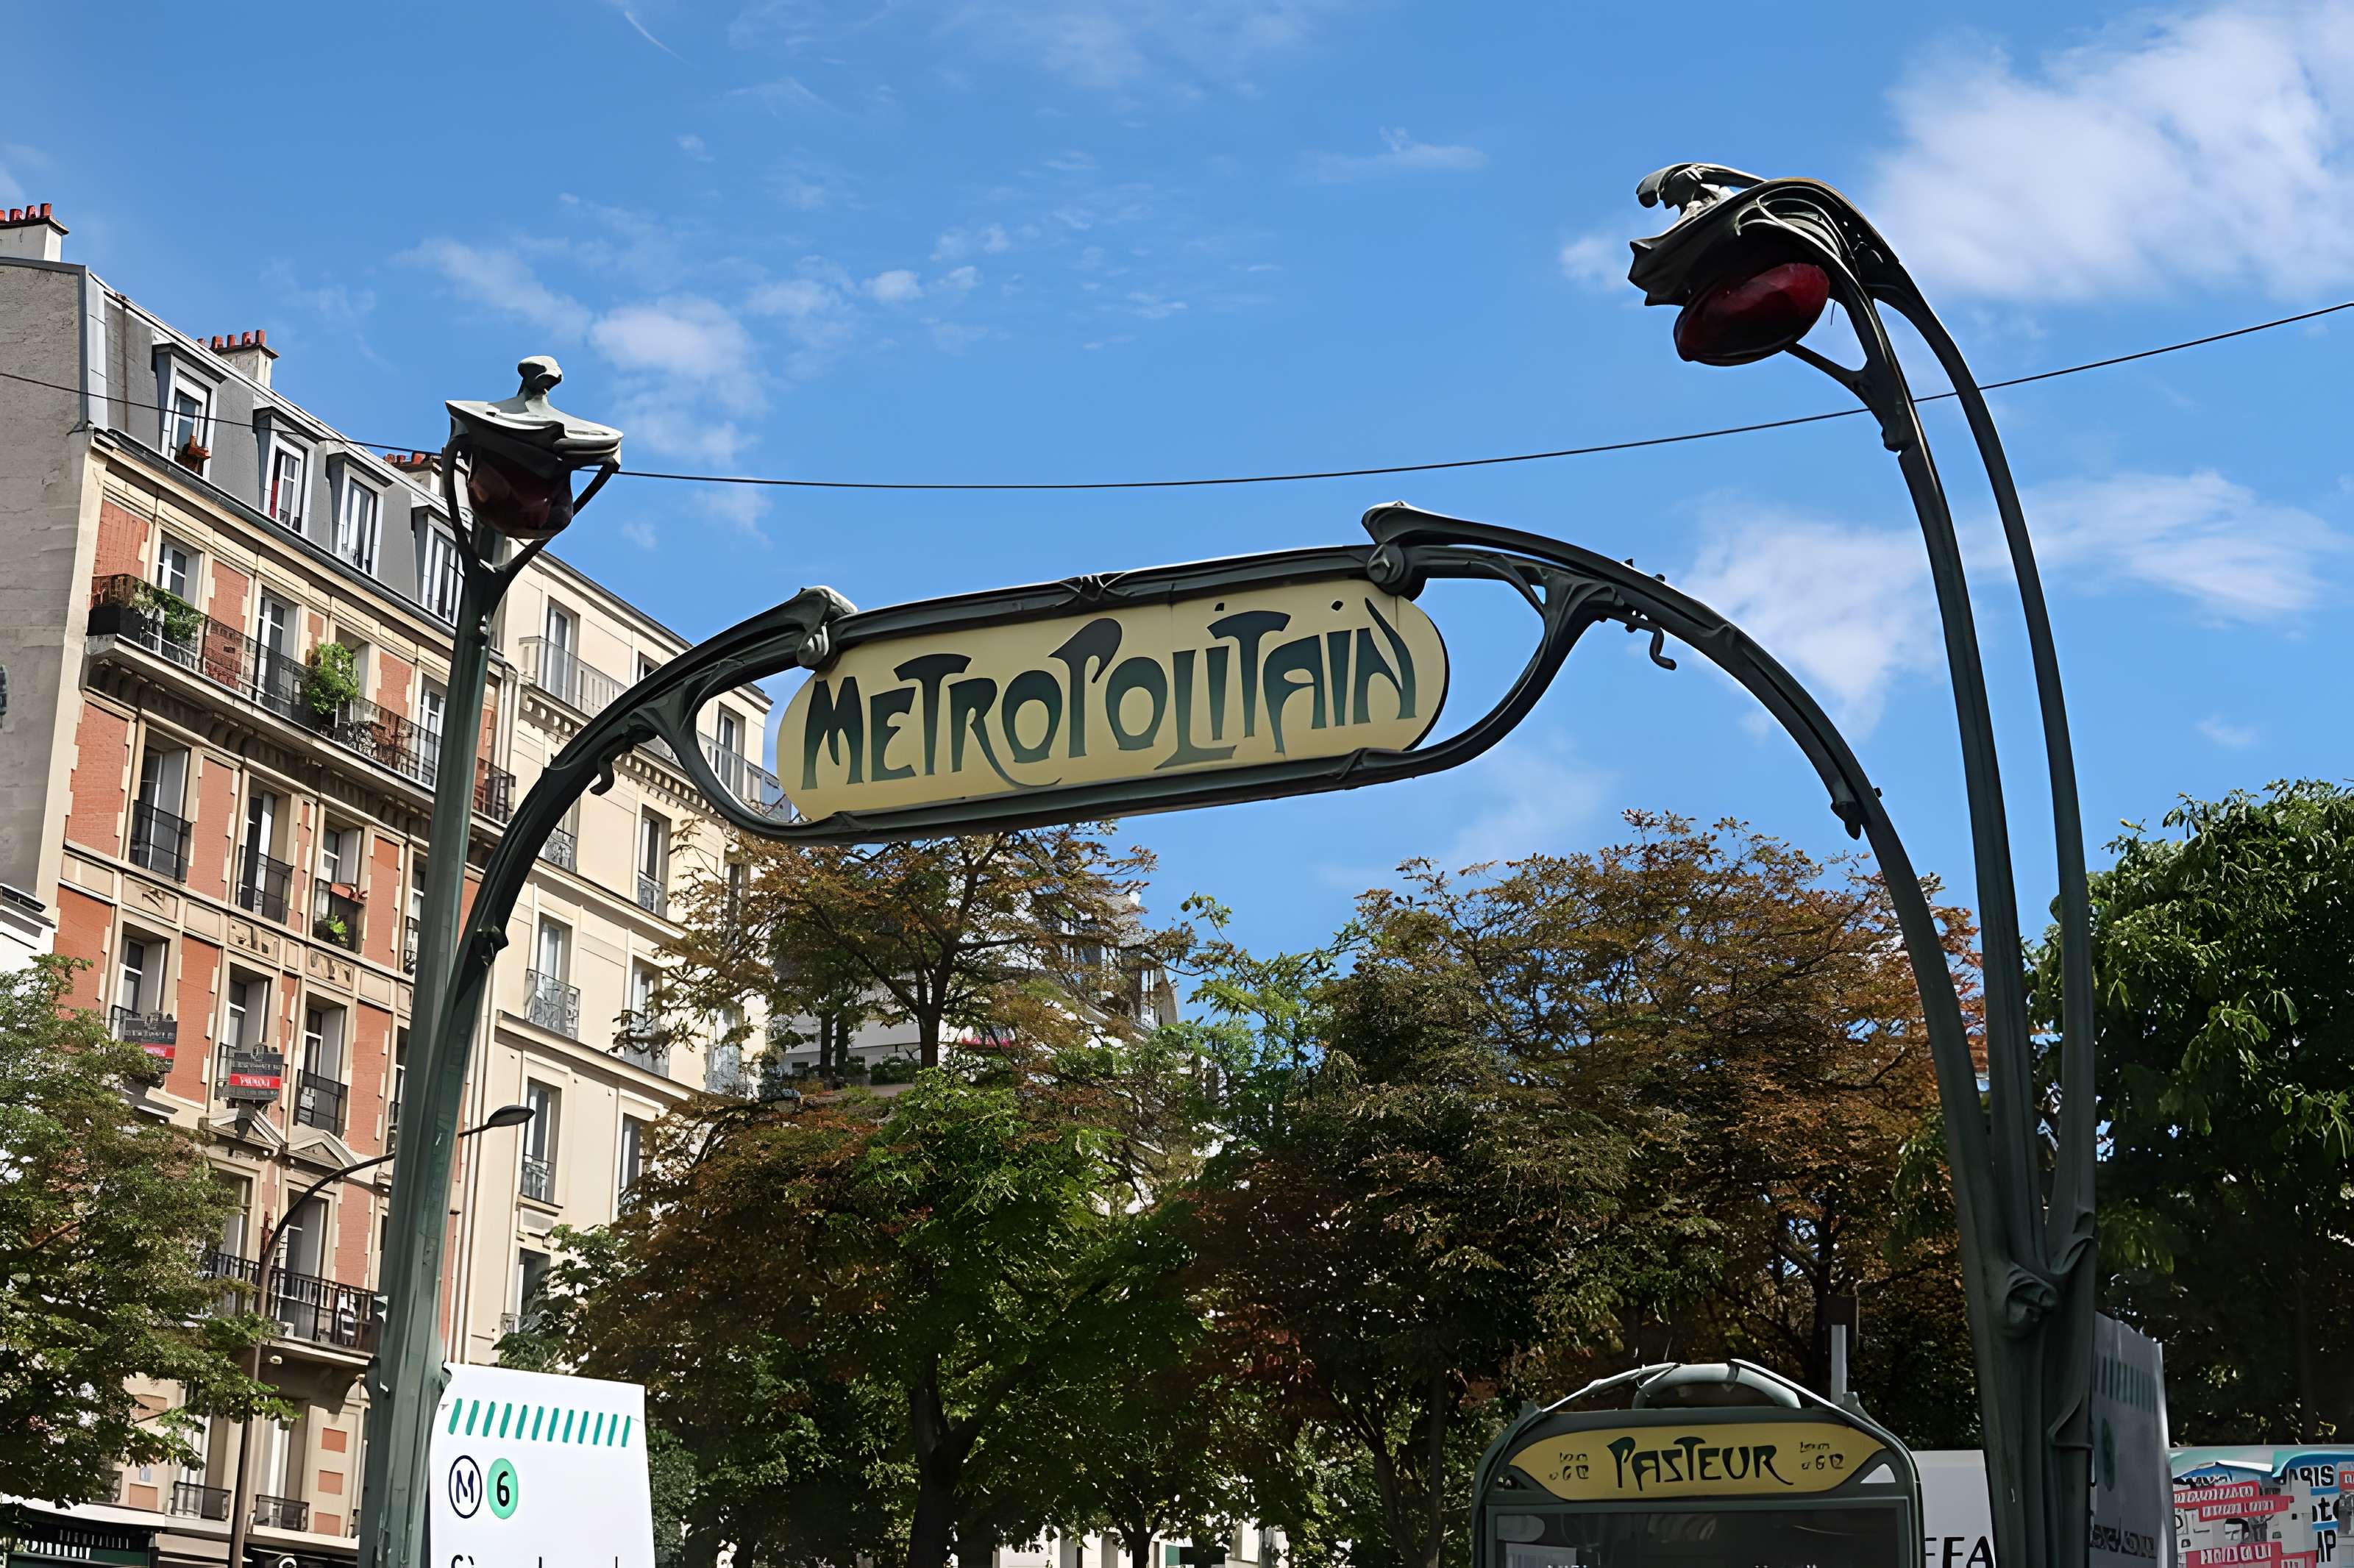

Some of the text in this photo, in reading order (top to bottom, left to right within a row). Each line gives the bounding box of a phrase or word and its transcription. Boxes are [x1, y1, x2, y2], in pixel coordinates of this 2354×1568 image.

[801, 597, 1416, 791] METROPOLITAIN
[497, 1470, 510, 1507] 6
[1606, 1436, 1794, 1492] PASTEUR
